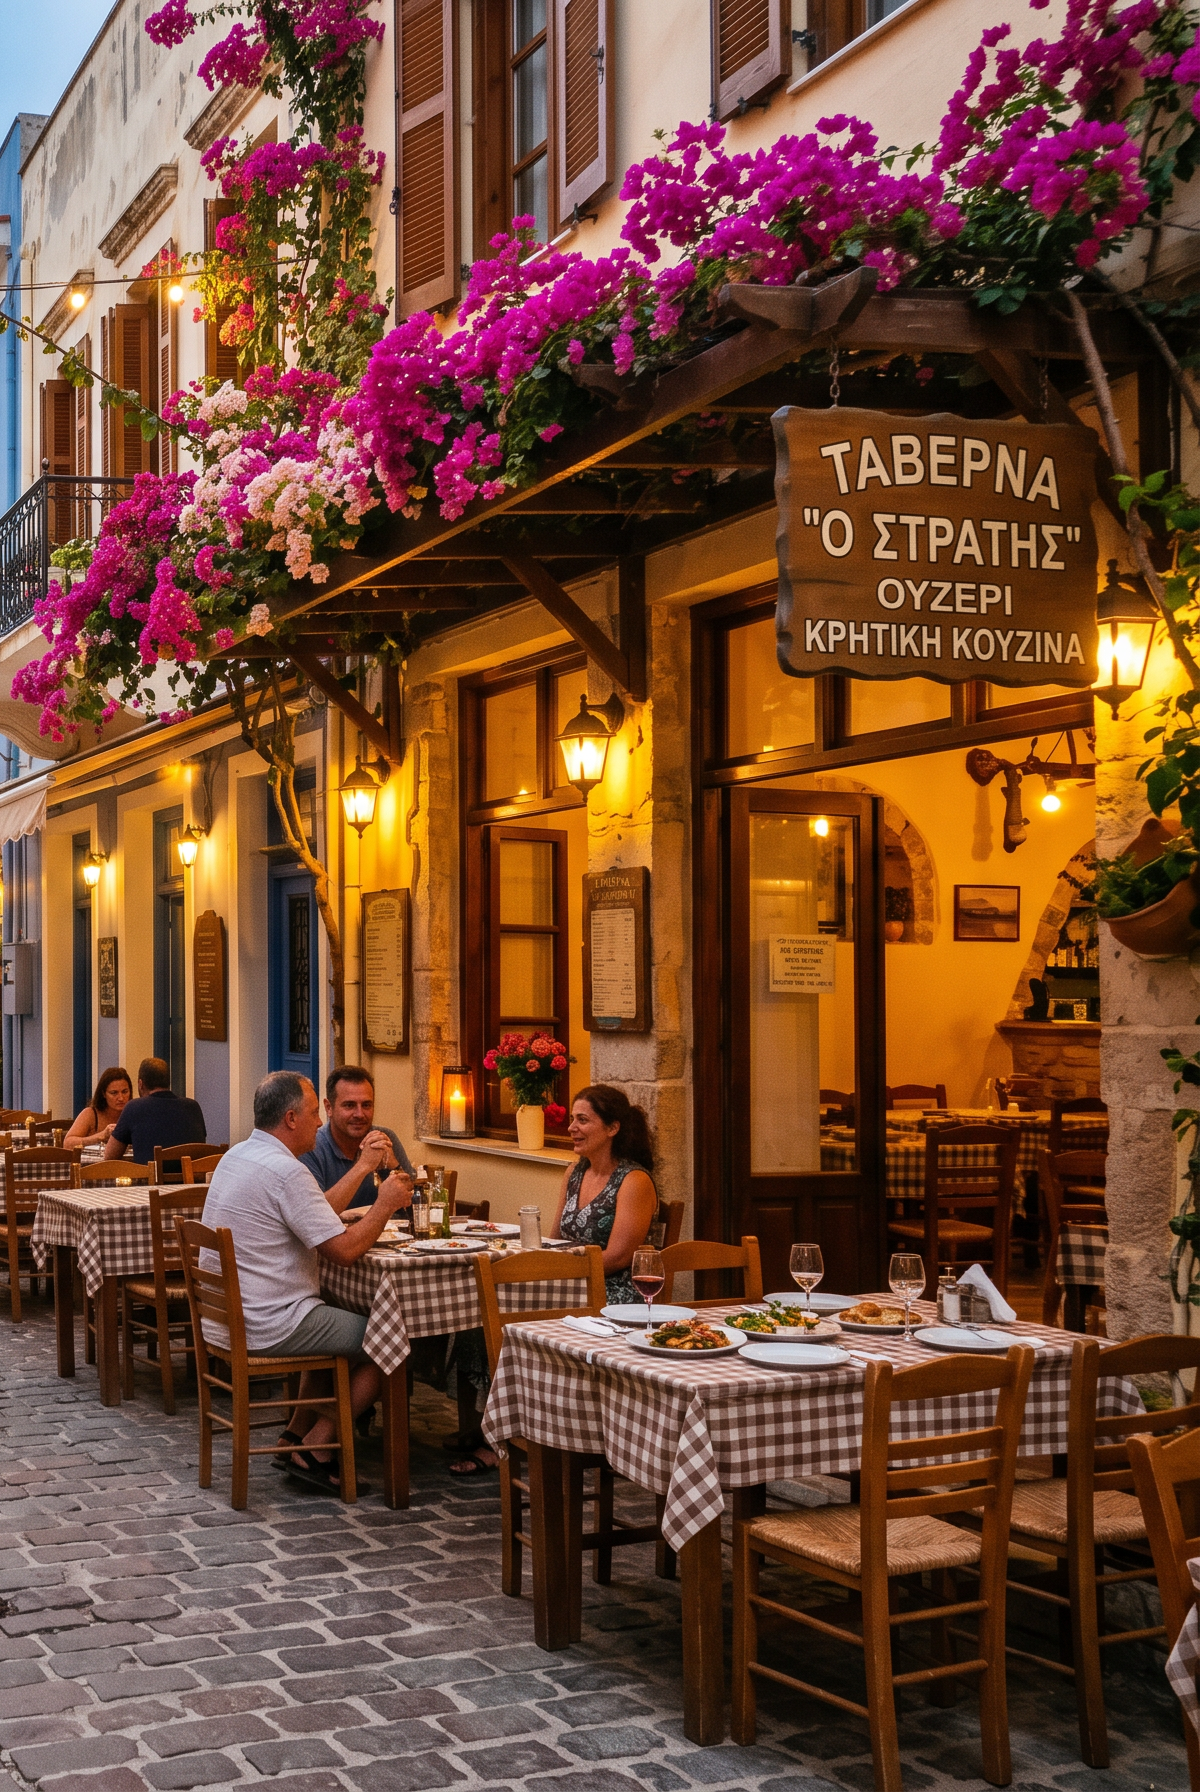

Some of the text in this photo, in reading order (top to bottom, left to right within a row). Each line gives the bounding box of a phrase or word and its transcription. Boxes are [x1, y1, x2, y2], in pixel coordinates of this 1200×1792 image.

[820, 434, 1060, 510] ΤΑΒΕΡΝΑ
[804, 508, 1081, 570] "Ο ΣΤΡΑΤΗΣ"
[877, 578, 1012, 616] ΟΥΖΕΡΙ
[805, 619, 1086, 665] ΚΡΗΤΙΚΗ ΚΟΥΖΙΝΑ
